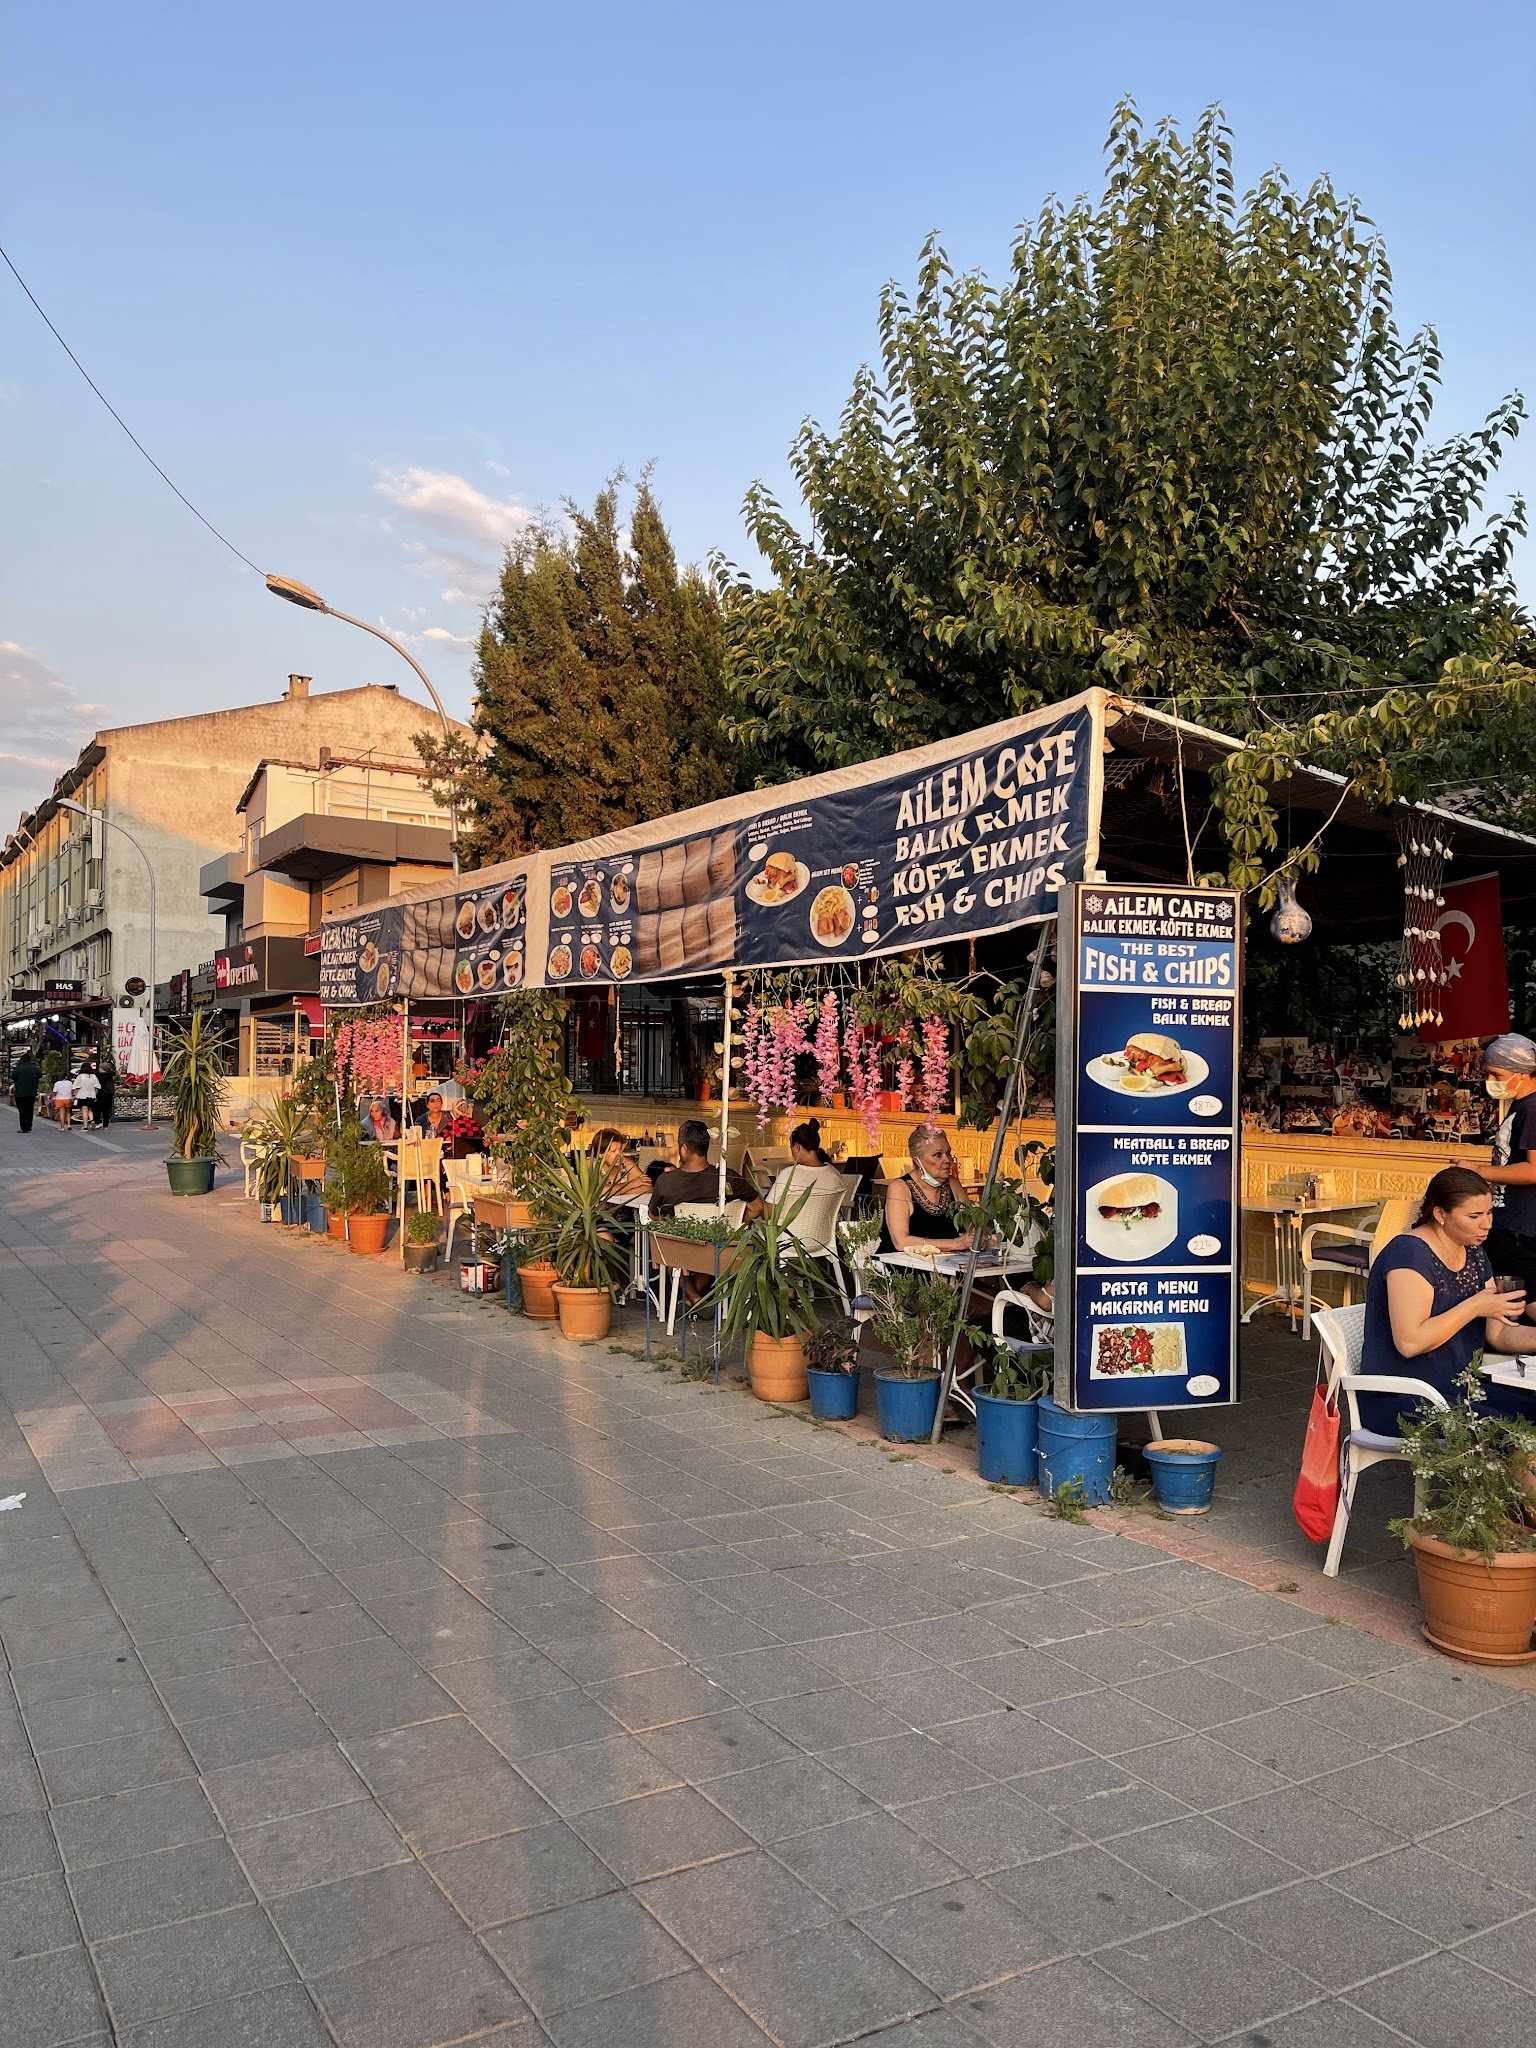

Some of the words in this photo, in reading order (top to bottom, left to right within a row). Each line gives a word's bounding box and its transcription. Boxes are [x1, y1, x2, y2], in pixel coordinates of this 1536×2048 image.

[994, 730, 1077, 799] CAFE
[895, 819, 972, 862] BALIK
[970, 822, 1071, 874] EKMEK
[953, 886, 977, 915] &
[984, 861, 1067, 908] CHIPS
[1168, 898, 1215, 920] CAFE
[1083, 919, 1117, 934] BALIK
[1118, 917, 1195, 937] EKMEK-KÖFTE
[1195, 922, 1233, 939] EKMEK
[1120, 942, 1153, 956] THE
[1157, 944, 1197, 958] BEST
[1085, 946, 1137, 982] FISH
[1142, 961, 1160, 983] &
[1164, 952, 1231, 986] CHIPS
[1151, 998, 1177, 1010] FISH
[1180, 999, 1189, 1010] &
[1192, 999, 1232, 1012] BREAD
[1152, 1013, 1187, 1026] BALIK
[1190, 1014, 1230, 1027] EKMEK
[1113, 1138, 1175, 1150] MEATBALL
[1178, 1139, 1187, 1150] &
[1190, 1139, 1230, 1151] BREAD
[1131, 1152, 1169, 1166] KÖFTE
[1172, 1153, 1212, 1166] EKMEK
[1101, 1281, 1148, 1297] PASTA
[1157, 1280, 1199, 1295] MENU
[1090, 1300, 1164, 1316] MAKARNA
[1168, 1299, 1209, 1314] MENU
